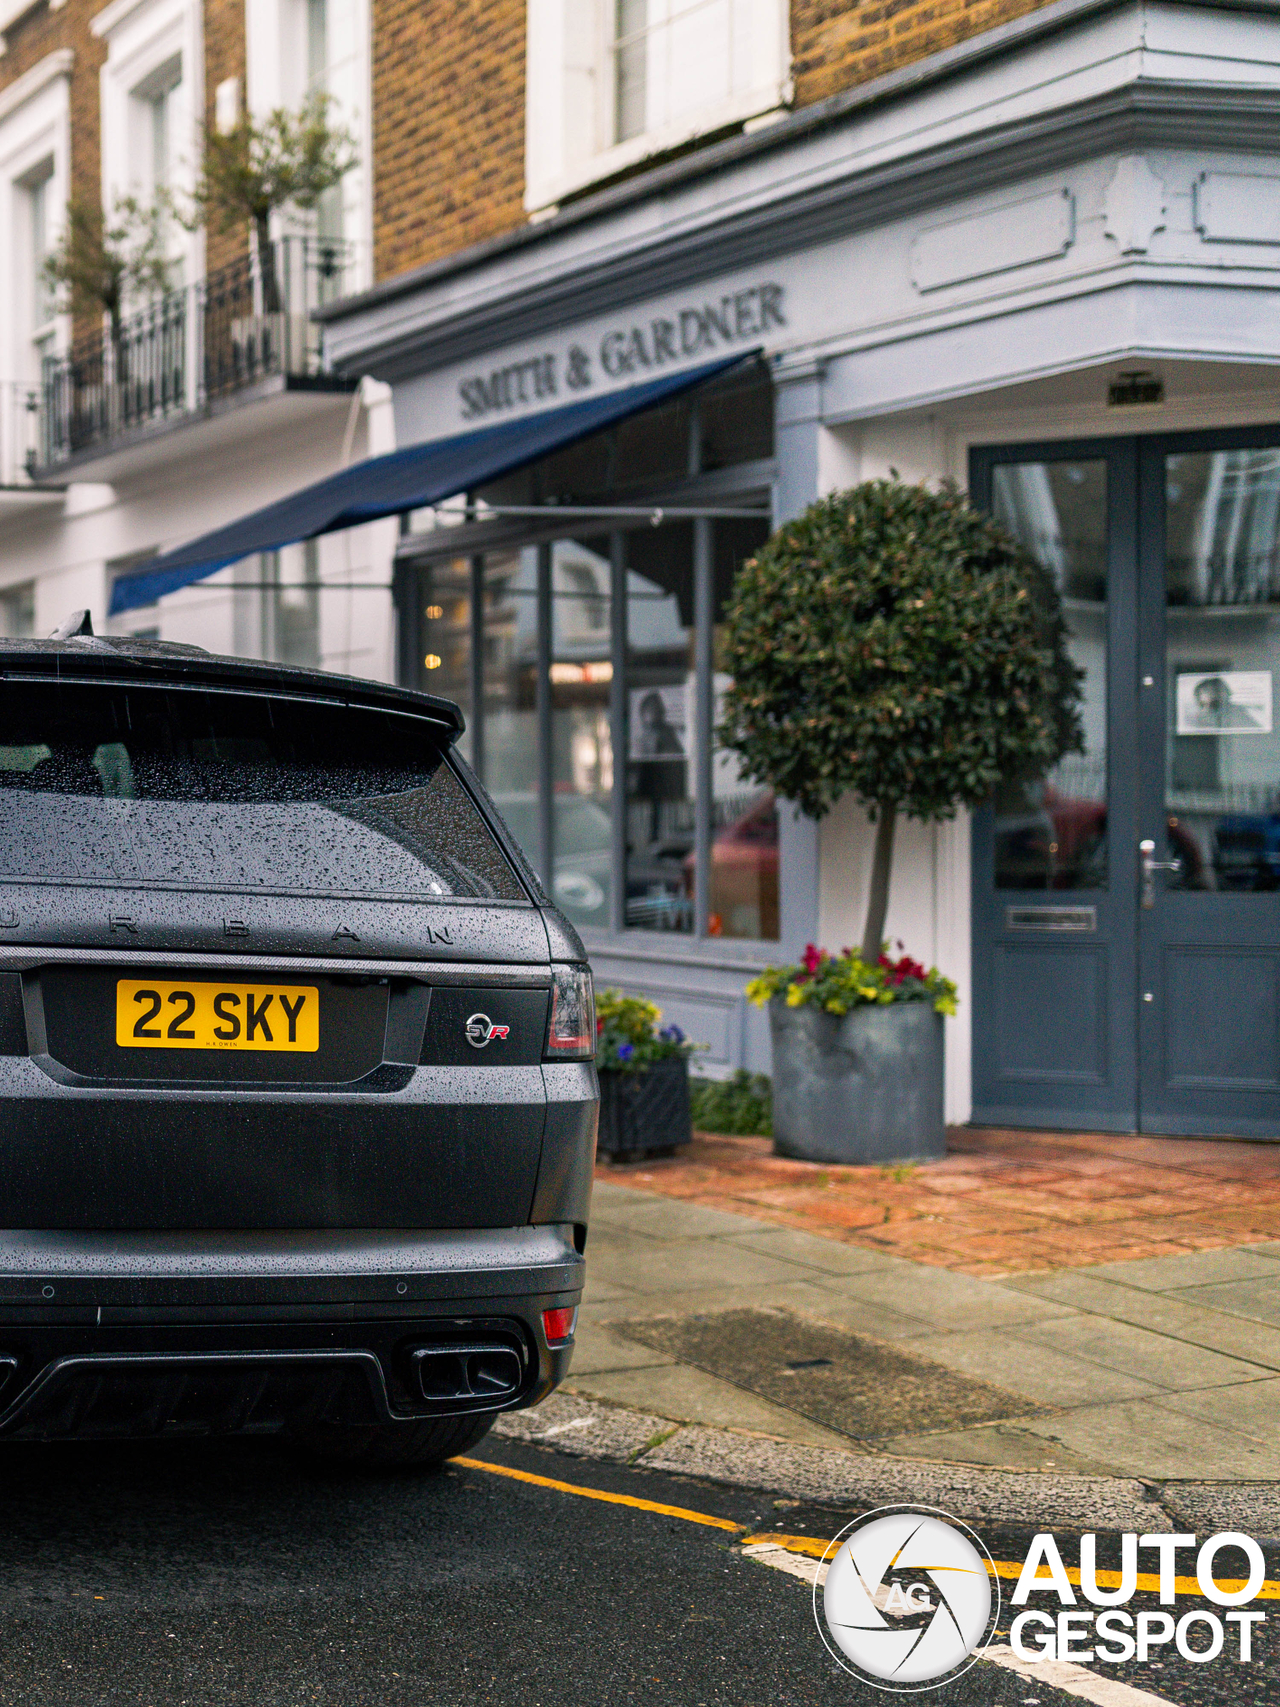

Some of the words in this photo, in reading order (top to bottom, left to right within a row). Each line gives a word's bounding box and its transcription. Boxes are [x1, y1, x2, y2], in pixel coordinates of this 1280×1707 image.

[458, 353, 558, 421] SMITH
[566, 344, 593, 391] &
[599, 281, 788, 379] GARDNER
[133, 989, 196, 1040] 22
[213, 992, 307, 1043] SKY
[465, 1021, 510, 1041] SVR
